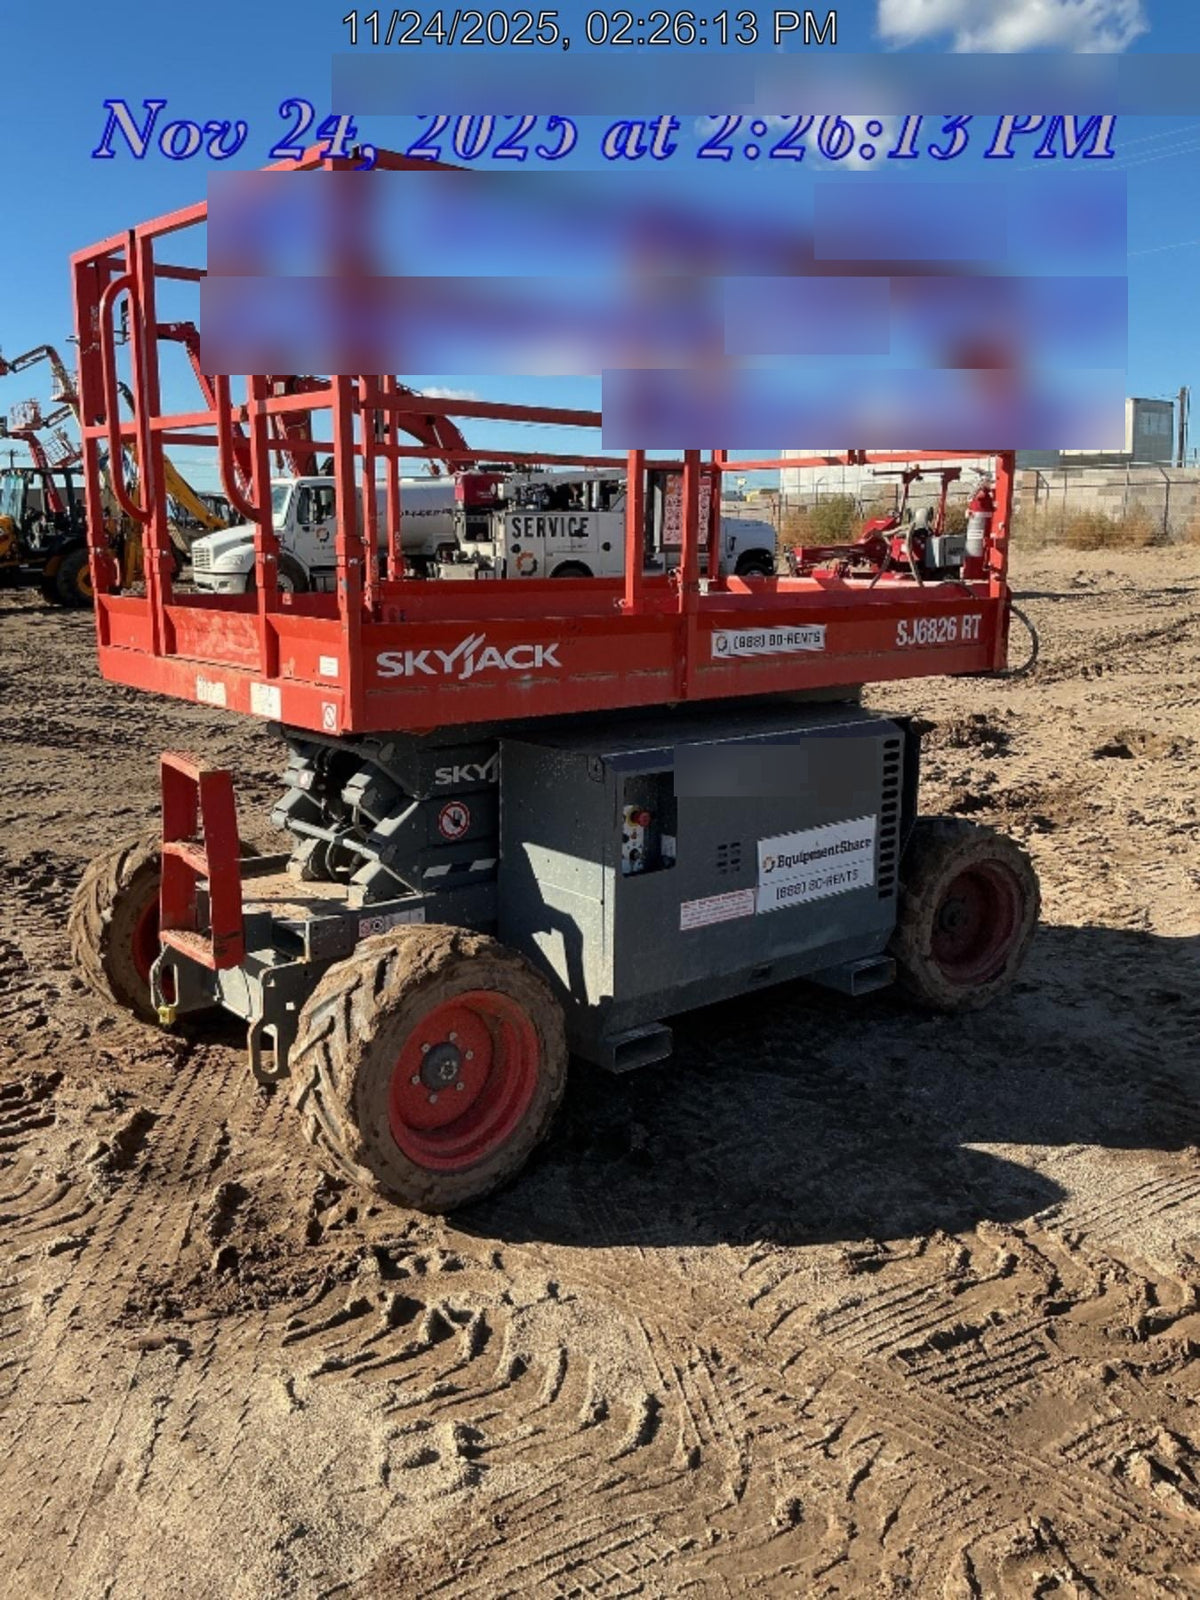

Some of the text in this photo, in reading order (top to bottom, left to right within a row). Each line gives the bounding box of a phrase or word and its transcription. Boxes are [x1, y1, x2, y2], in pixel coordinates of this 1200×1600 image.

[511, 517, 589, 538] SERVICE
[896, 614, 982, 646] SJ6826 RT
[376, 632, 562, 680] SKYJACK
[776, 837, 872, 869] EquipmentShare
